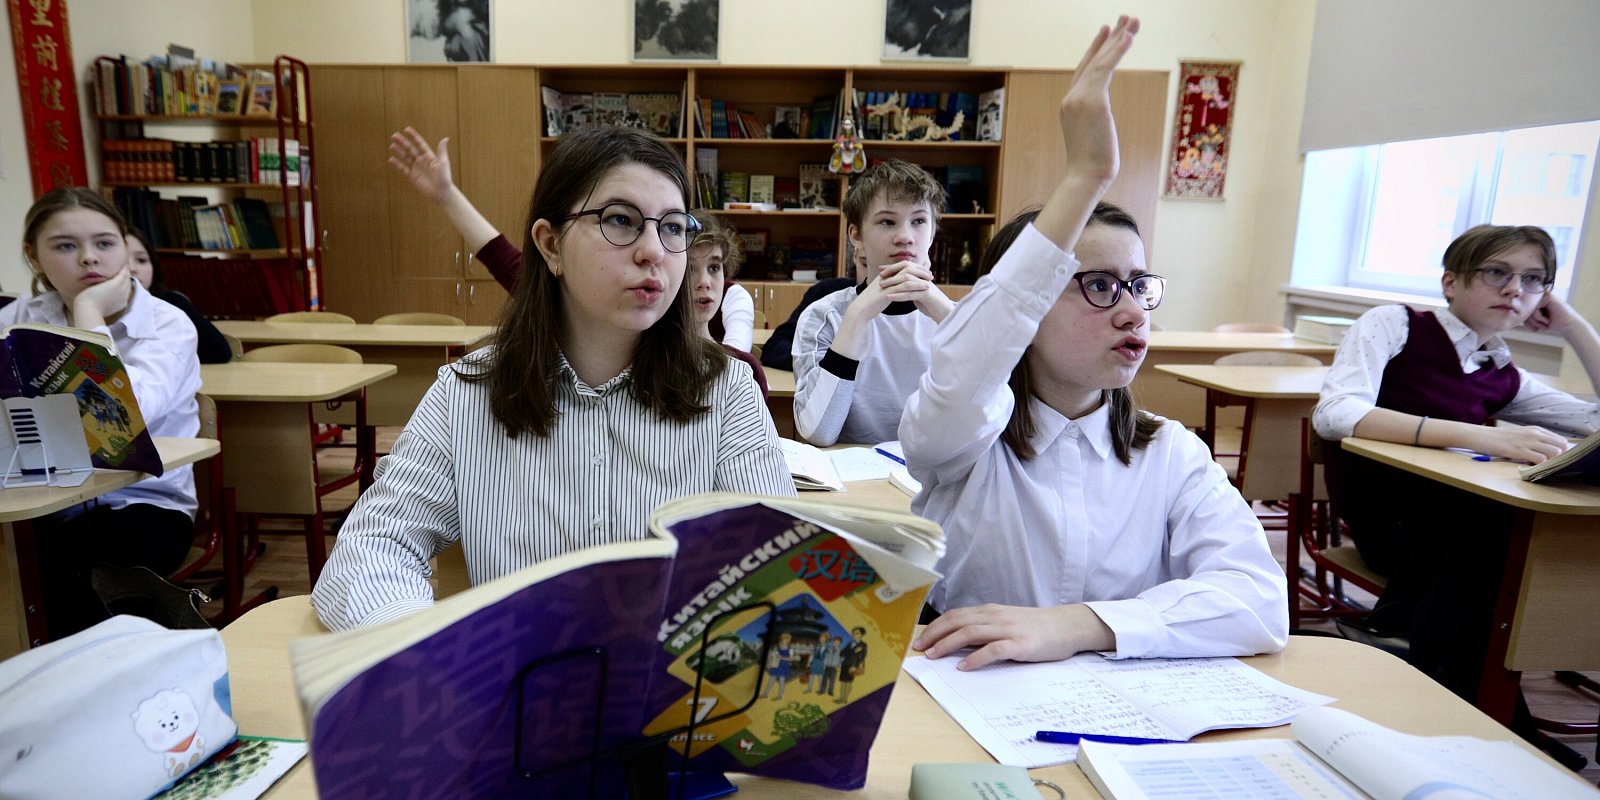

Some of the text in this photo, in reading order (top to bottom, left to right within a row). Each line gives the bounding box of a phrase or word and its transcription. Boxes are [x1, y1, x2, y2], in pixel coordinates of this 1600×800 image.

[30, 341, 76, 388] Китайский
[657, 521, 821, 643] Китайский
[797, 548, 877, 584] 汉语
[670, 586, 753, 650] язык
[686, 696, 718, 726] 7
